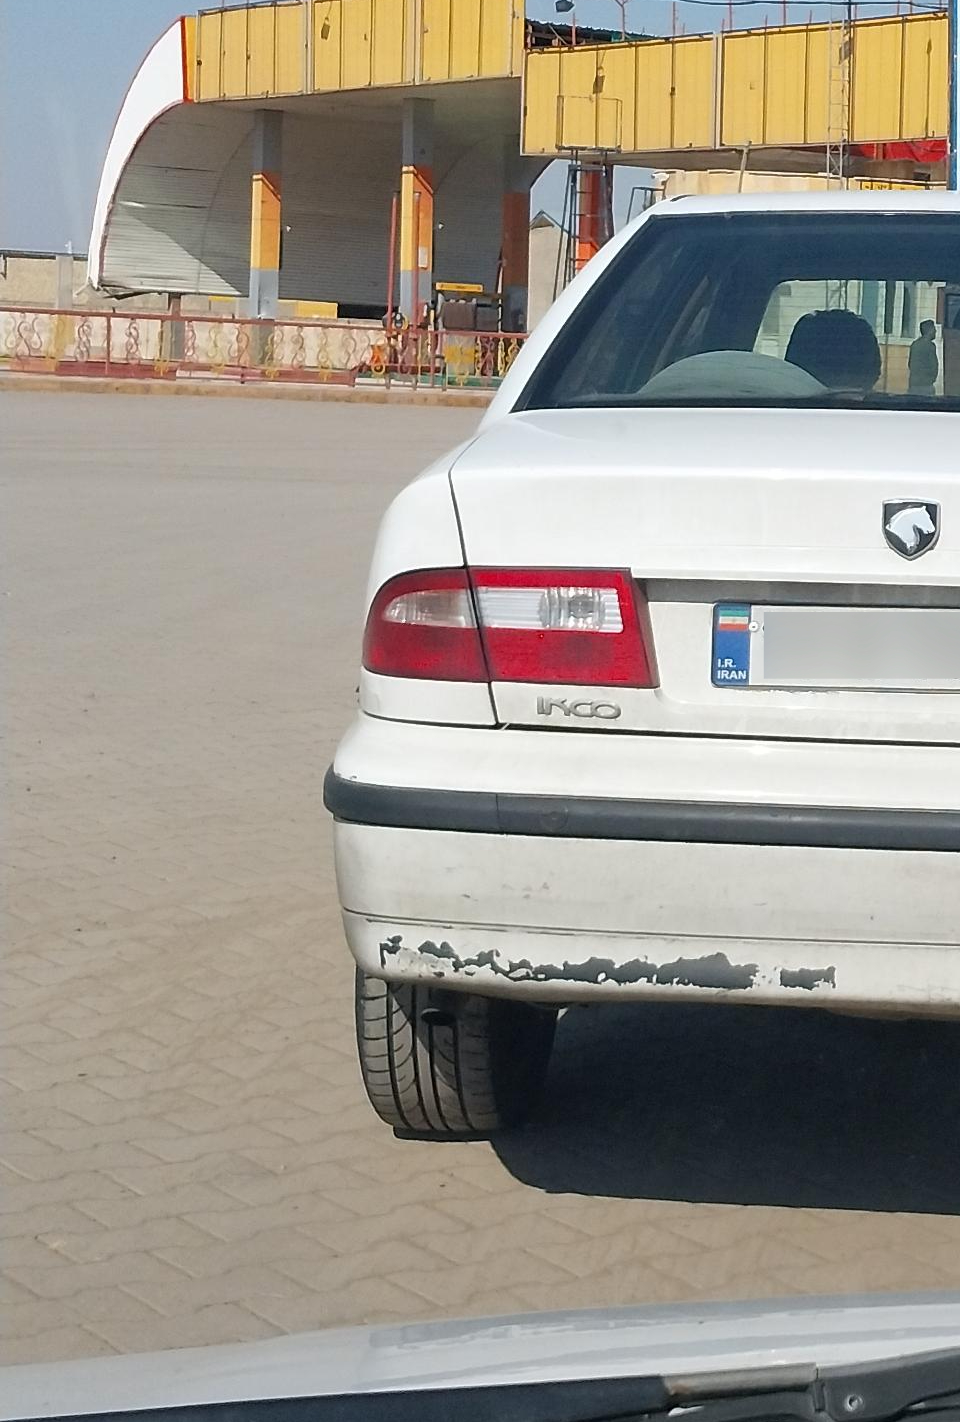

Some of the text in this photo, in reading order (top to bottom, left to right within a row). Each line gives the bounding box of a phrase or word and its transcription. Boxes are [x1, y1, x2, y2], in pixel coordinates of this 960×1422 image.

[717, 658, 737, 668] I.R.
[717, 669, 747, 680] IRAN
[537, 696, 621, 719] IKCO
